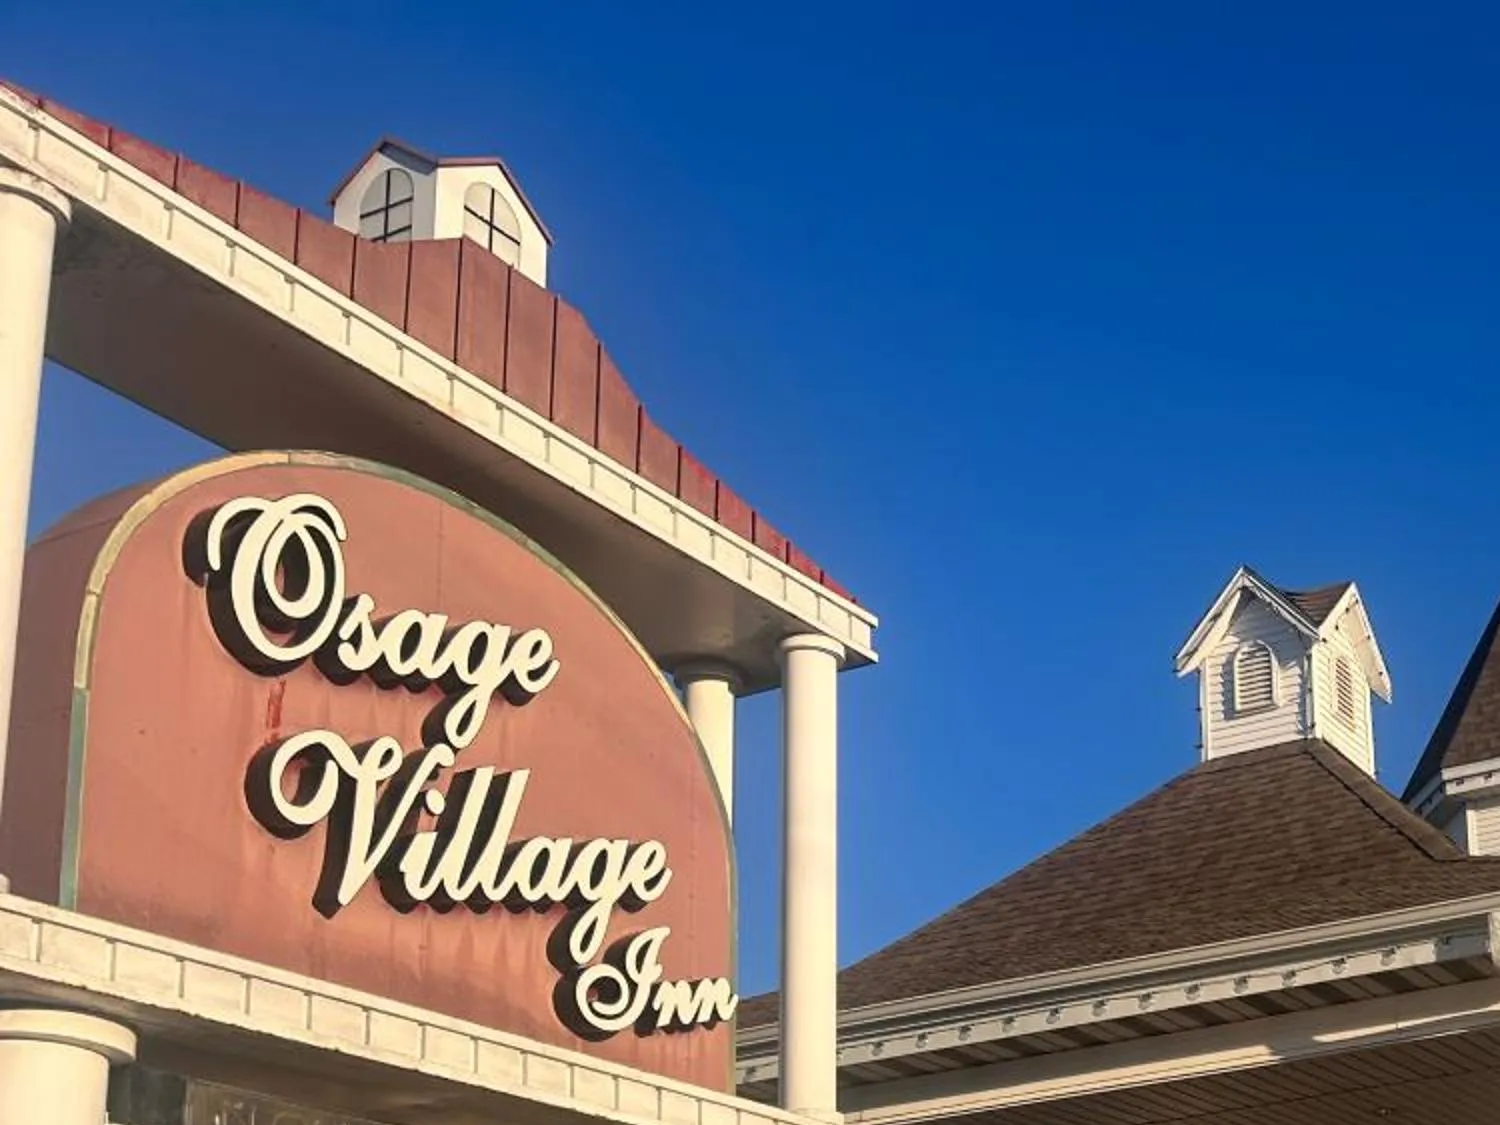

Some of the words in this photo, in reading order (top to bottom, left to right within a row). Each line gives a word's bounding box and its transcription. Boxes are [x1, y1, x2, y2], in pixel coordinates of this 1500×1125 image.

[206, 493, 561, 748] Osage
[268, 729, 673, 960] Village
[574, 926, 738, 1033] Inn
